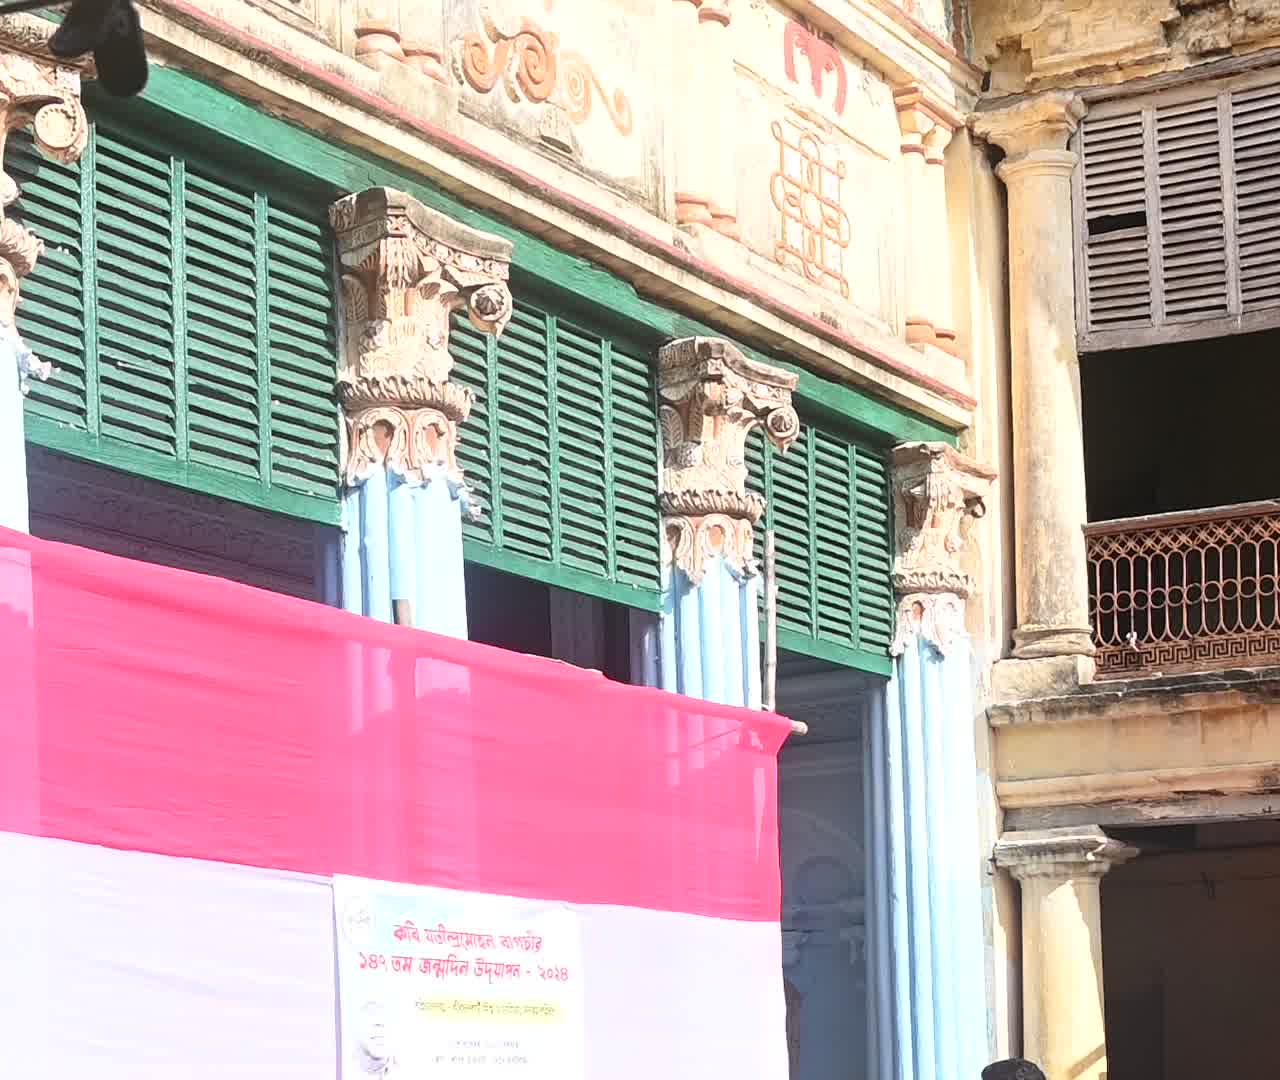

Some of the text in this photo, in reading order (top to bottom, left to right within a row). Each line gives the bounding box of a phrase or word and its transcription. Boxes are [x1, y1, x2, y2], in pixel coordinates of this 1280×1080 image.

[392, 920, 420, 943] কবি
[391, 955, 414, 973] তম
[419, 953, 469, 979] জন্মদিন
